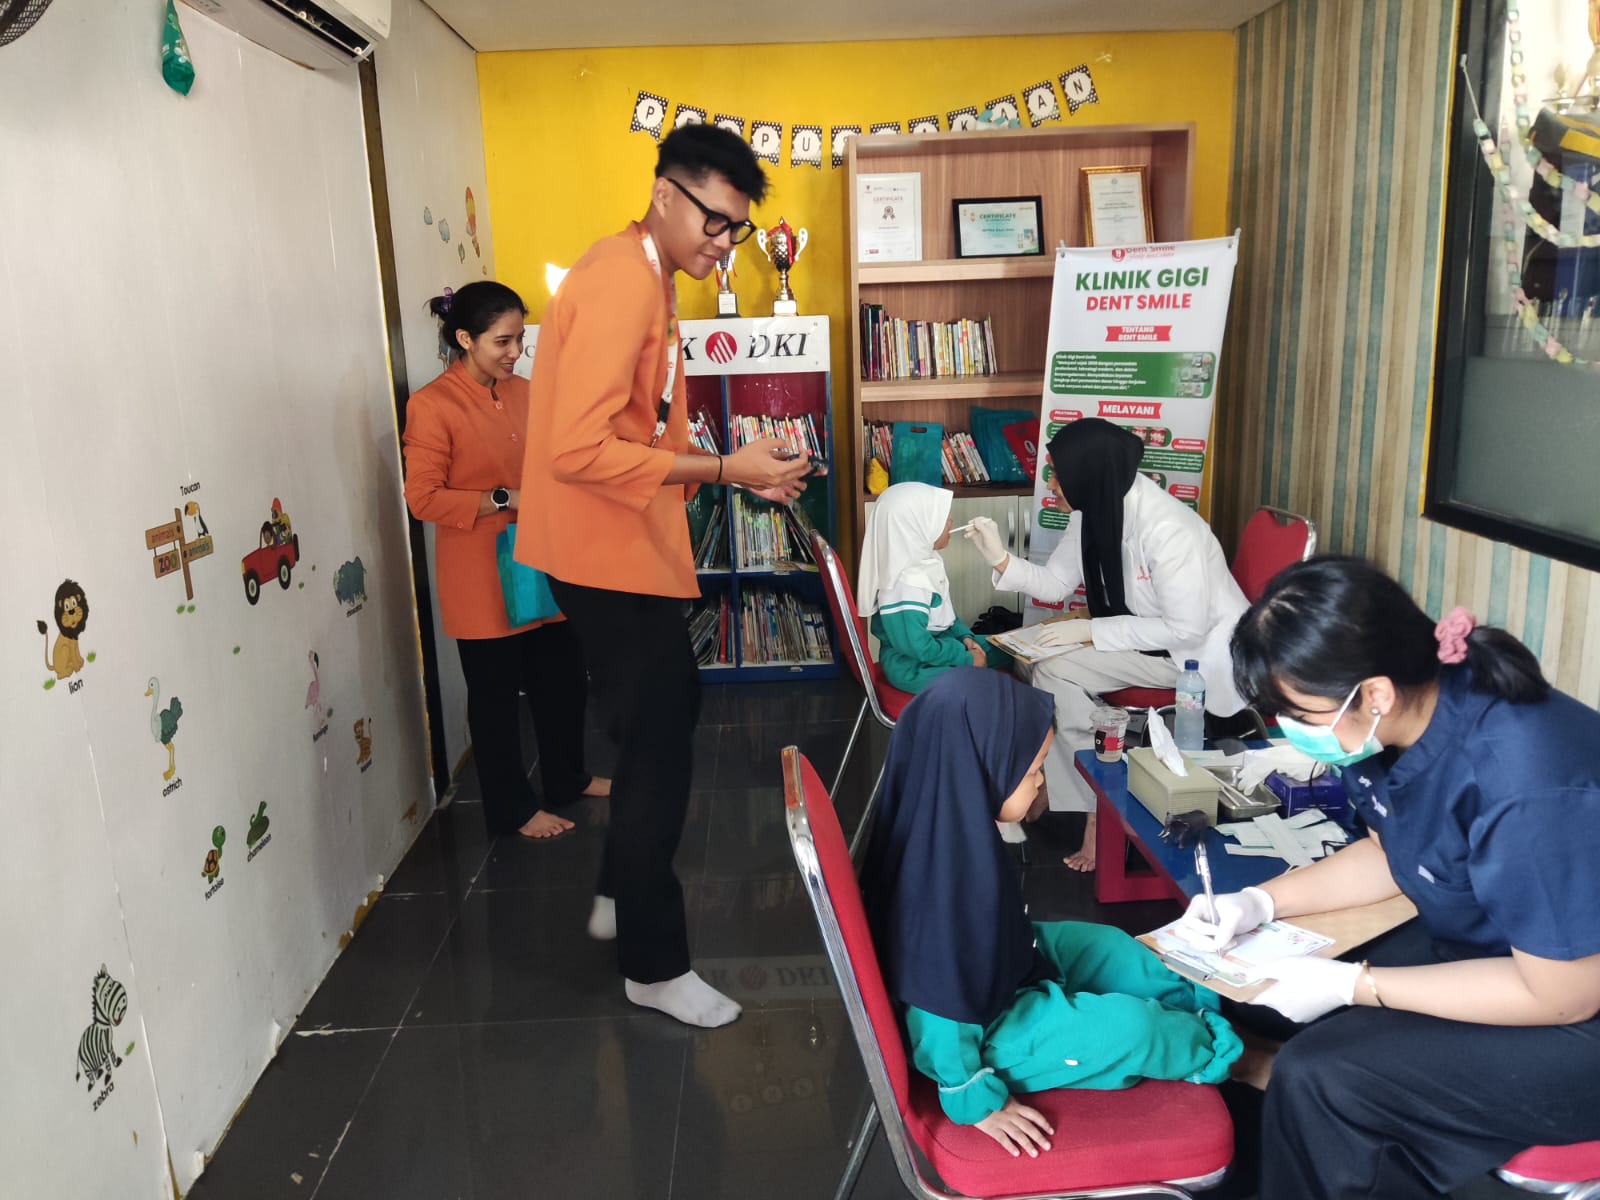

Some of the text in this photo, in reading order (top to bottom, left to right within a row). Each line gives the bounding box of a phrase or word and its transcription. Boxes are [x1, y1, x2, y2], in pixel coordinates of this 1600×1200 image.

[1075, 266, 1209, 291] KLINIK GIGI
[1086, 293, 1192, 311] DENT SMILE
[746, 333, 811, 358] DKI
[1102, 404, 1154, 416] MELAYANI
[180, 482, 201, 496] Toucan
[158, 553, 177, 573] ZOO
[68, 679, 84, 695] lion
[162, 777, 183, 797] ostrich
[93, 1081, 114, 1112] zebra
